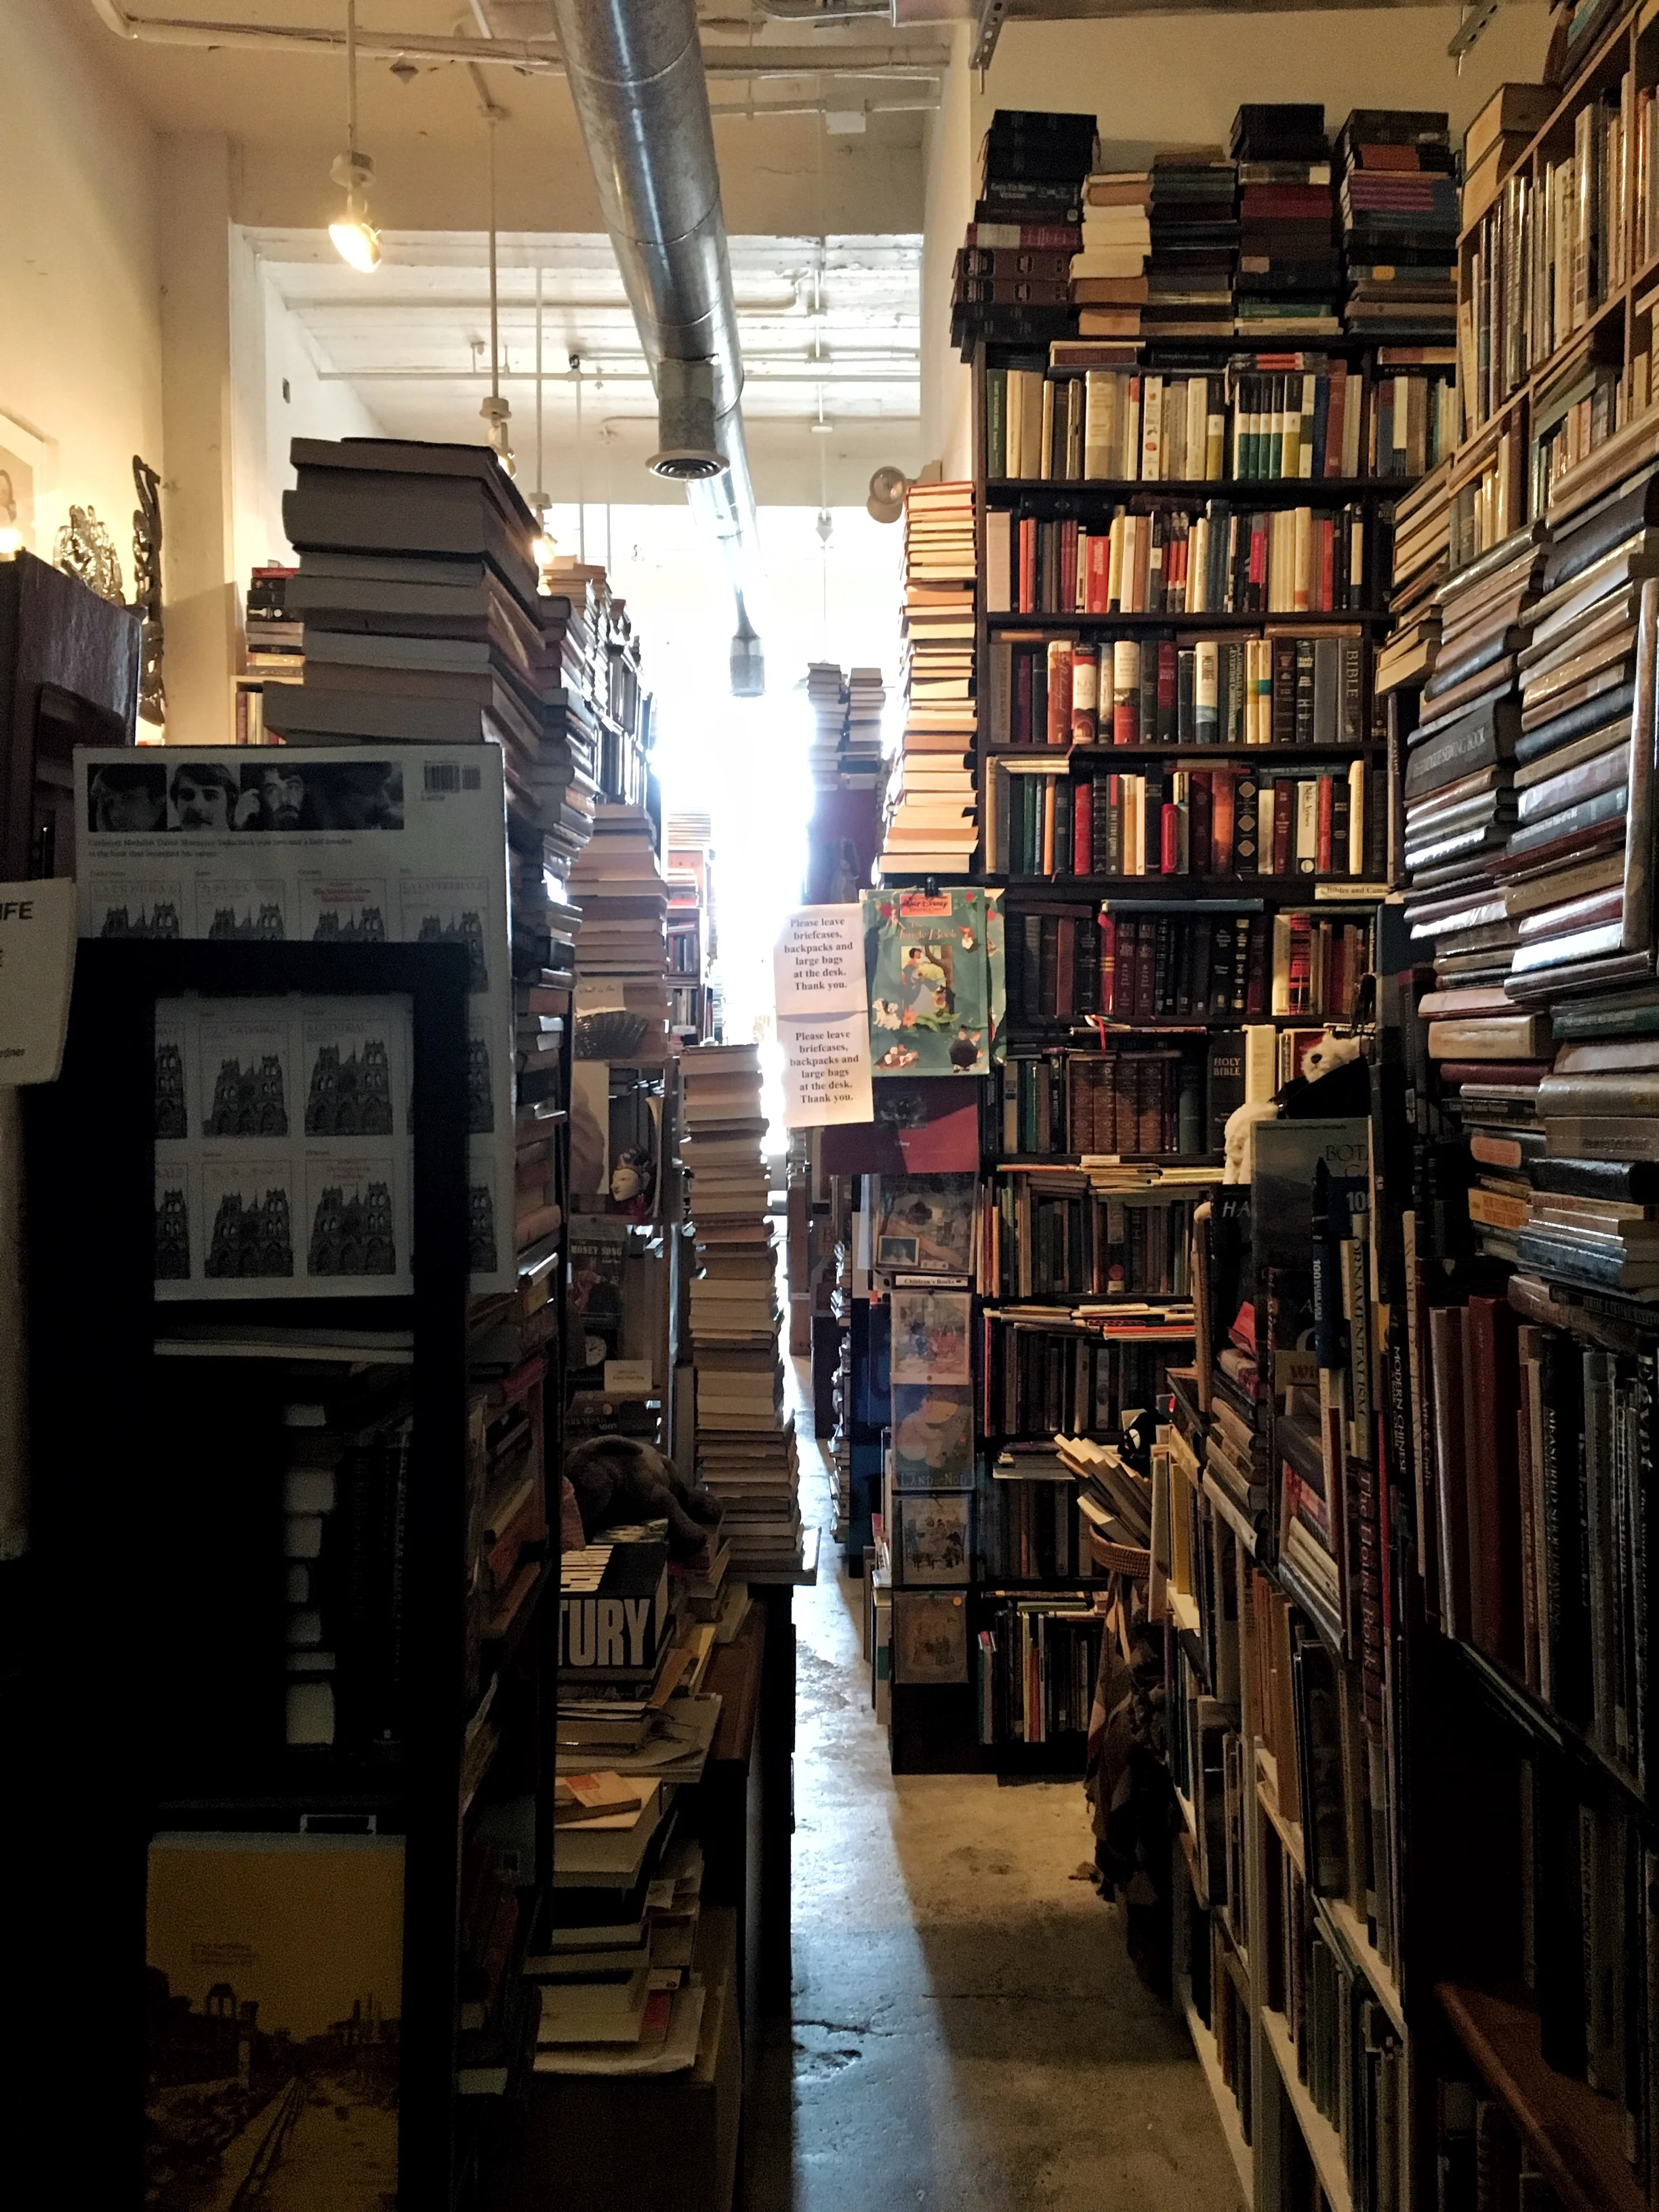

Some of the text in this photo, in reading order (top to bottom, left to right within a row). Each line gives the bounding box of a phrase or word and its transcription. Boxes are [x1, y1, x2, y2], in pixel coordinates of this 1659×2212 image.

[1346, 651, 1359, 699] BIBLE
[922, 899, 948, 909] Disney
[790, 918, 845, 928] Please leave
[794, 930, 842, 941] briefcases,
[899, 928, 958, 941] Jungle Book
[784, 942, 853, 954] backpacks and
[795, 956, 843, 966] large bags
[794, 968, 847, 978] at the desk.
[795, 981, 848, 991] Thank you.
[795, 1031, 851, 1041] Please leave
[799, 1043, 848, 1054] briefcases,
[790, 1055, 859, 1067] backpacks and
[1214, 1057, 1241, 1067] HOLY
[801, 1068, 849, 1080] large bags
[1213, 1067, 1241, 1076] BIBLE
[800, 1080, 853, 1090] at the desk.
[800, 1094, 854, 1104] Thank you.
[1325, 1144, 1368, 1162] BOT
[1346, 1191, 1370, 1212] 10
[1352, 1239, 1366, 1417] ORNAMENTALISM
[1393, 1346, 1407, 1475] MODERN CHINESE
[1423, 1446, 1433, 1488] Crafts
[1358, 1475, 1372, 1518] The
[1362, 1607, 1376, 1670] Book
